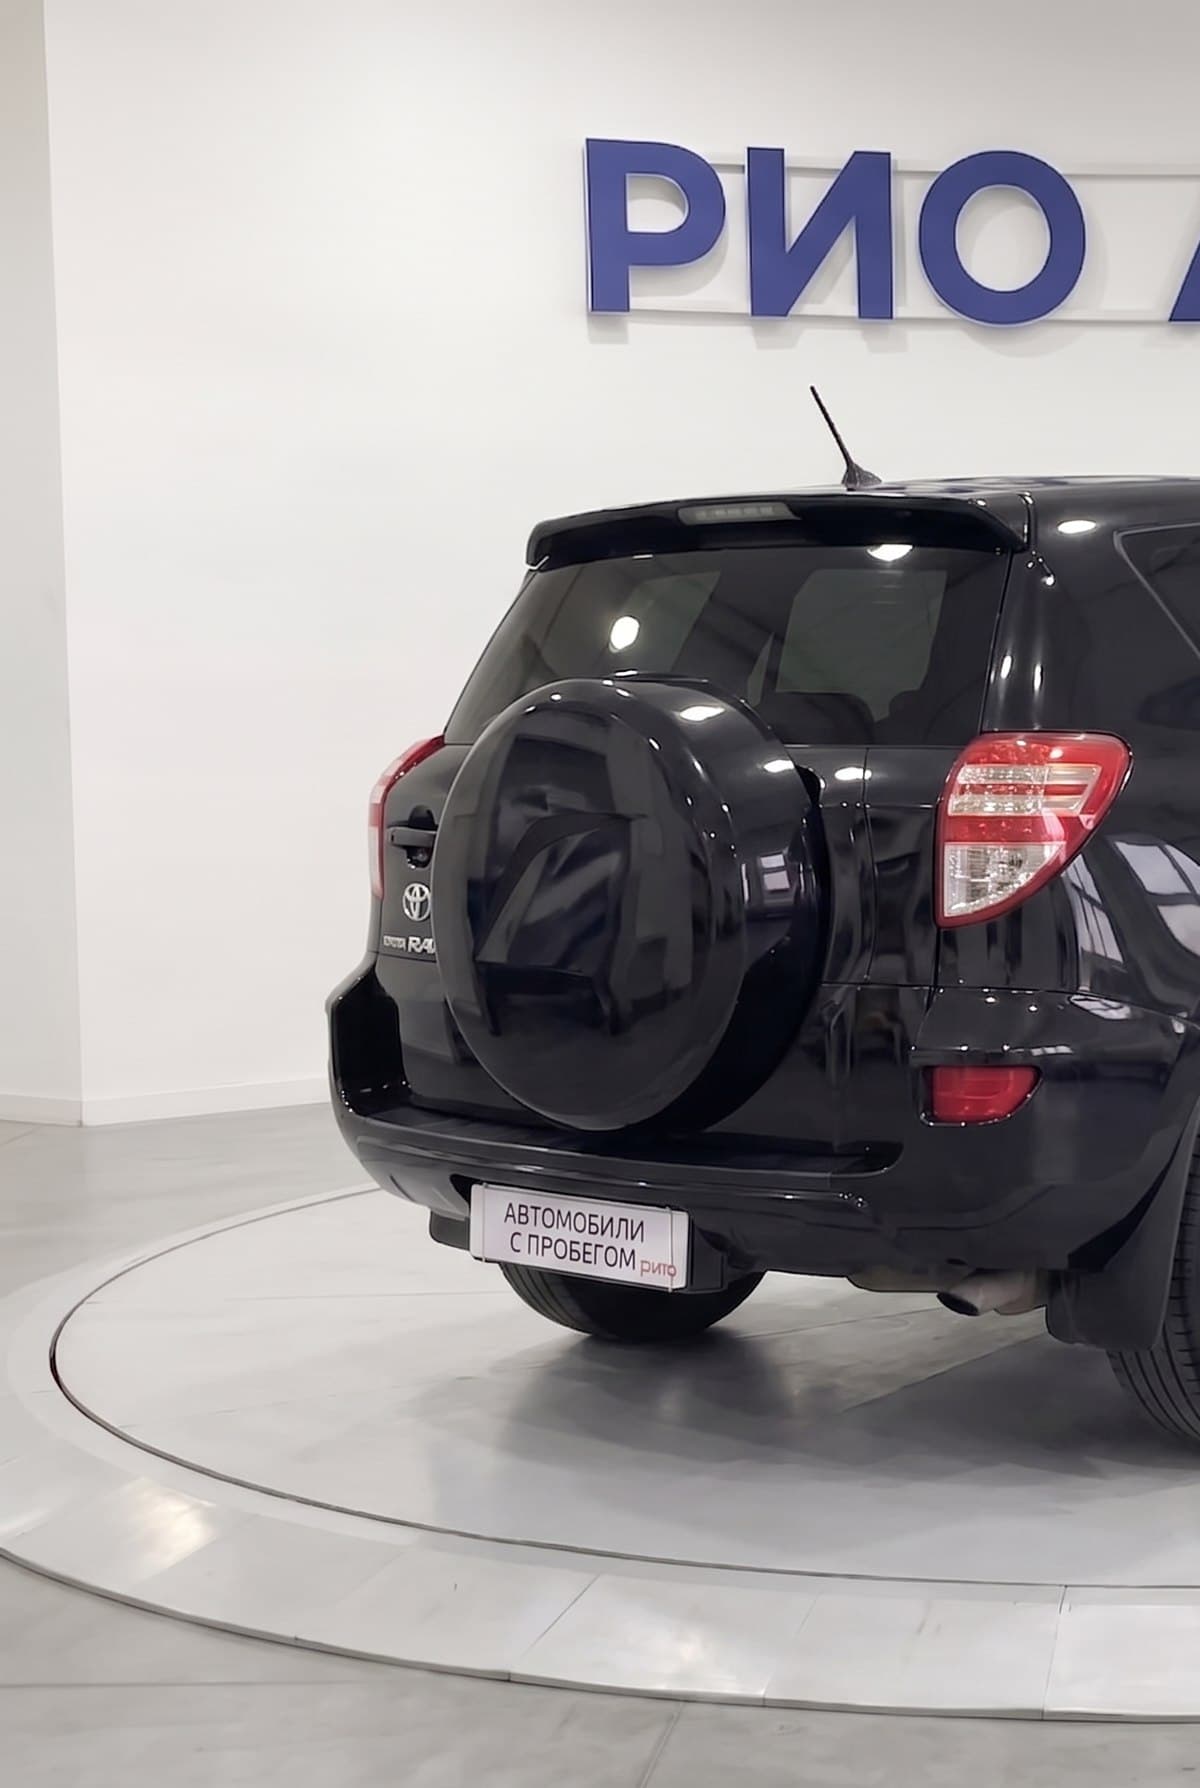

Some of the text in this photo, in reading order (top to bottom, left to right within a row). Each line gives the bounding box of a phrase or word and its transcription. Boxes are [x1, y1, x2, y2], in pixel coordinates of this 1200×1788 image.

[583, 138, 1085, 324] РИО
[504, 1202, 645, 1243] АВТОМОБИЛИ
[510, 1232, 636, 1271] С ПРОБЕГОМ
